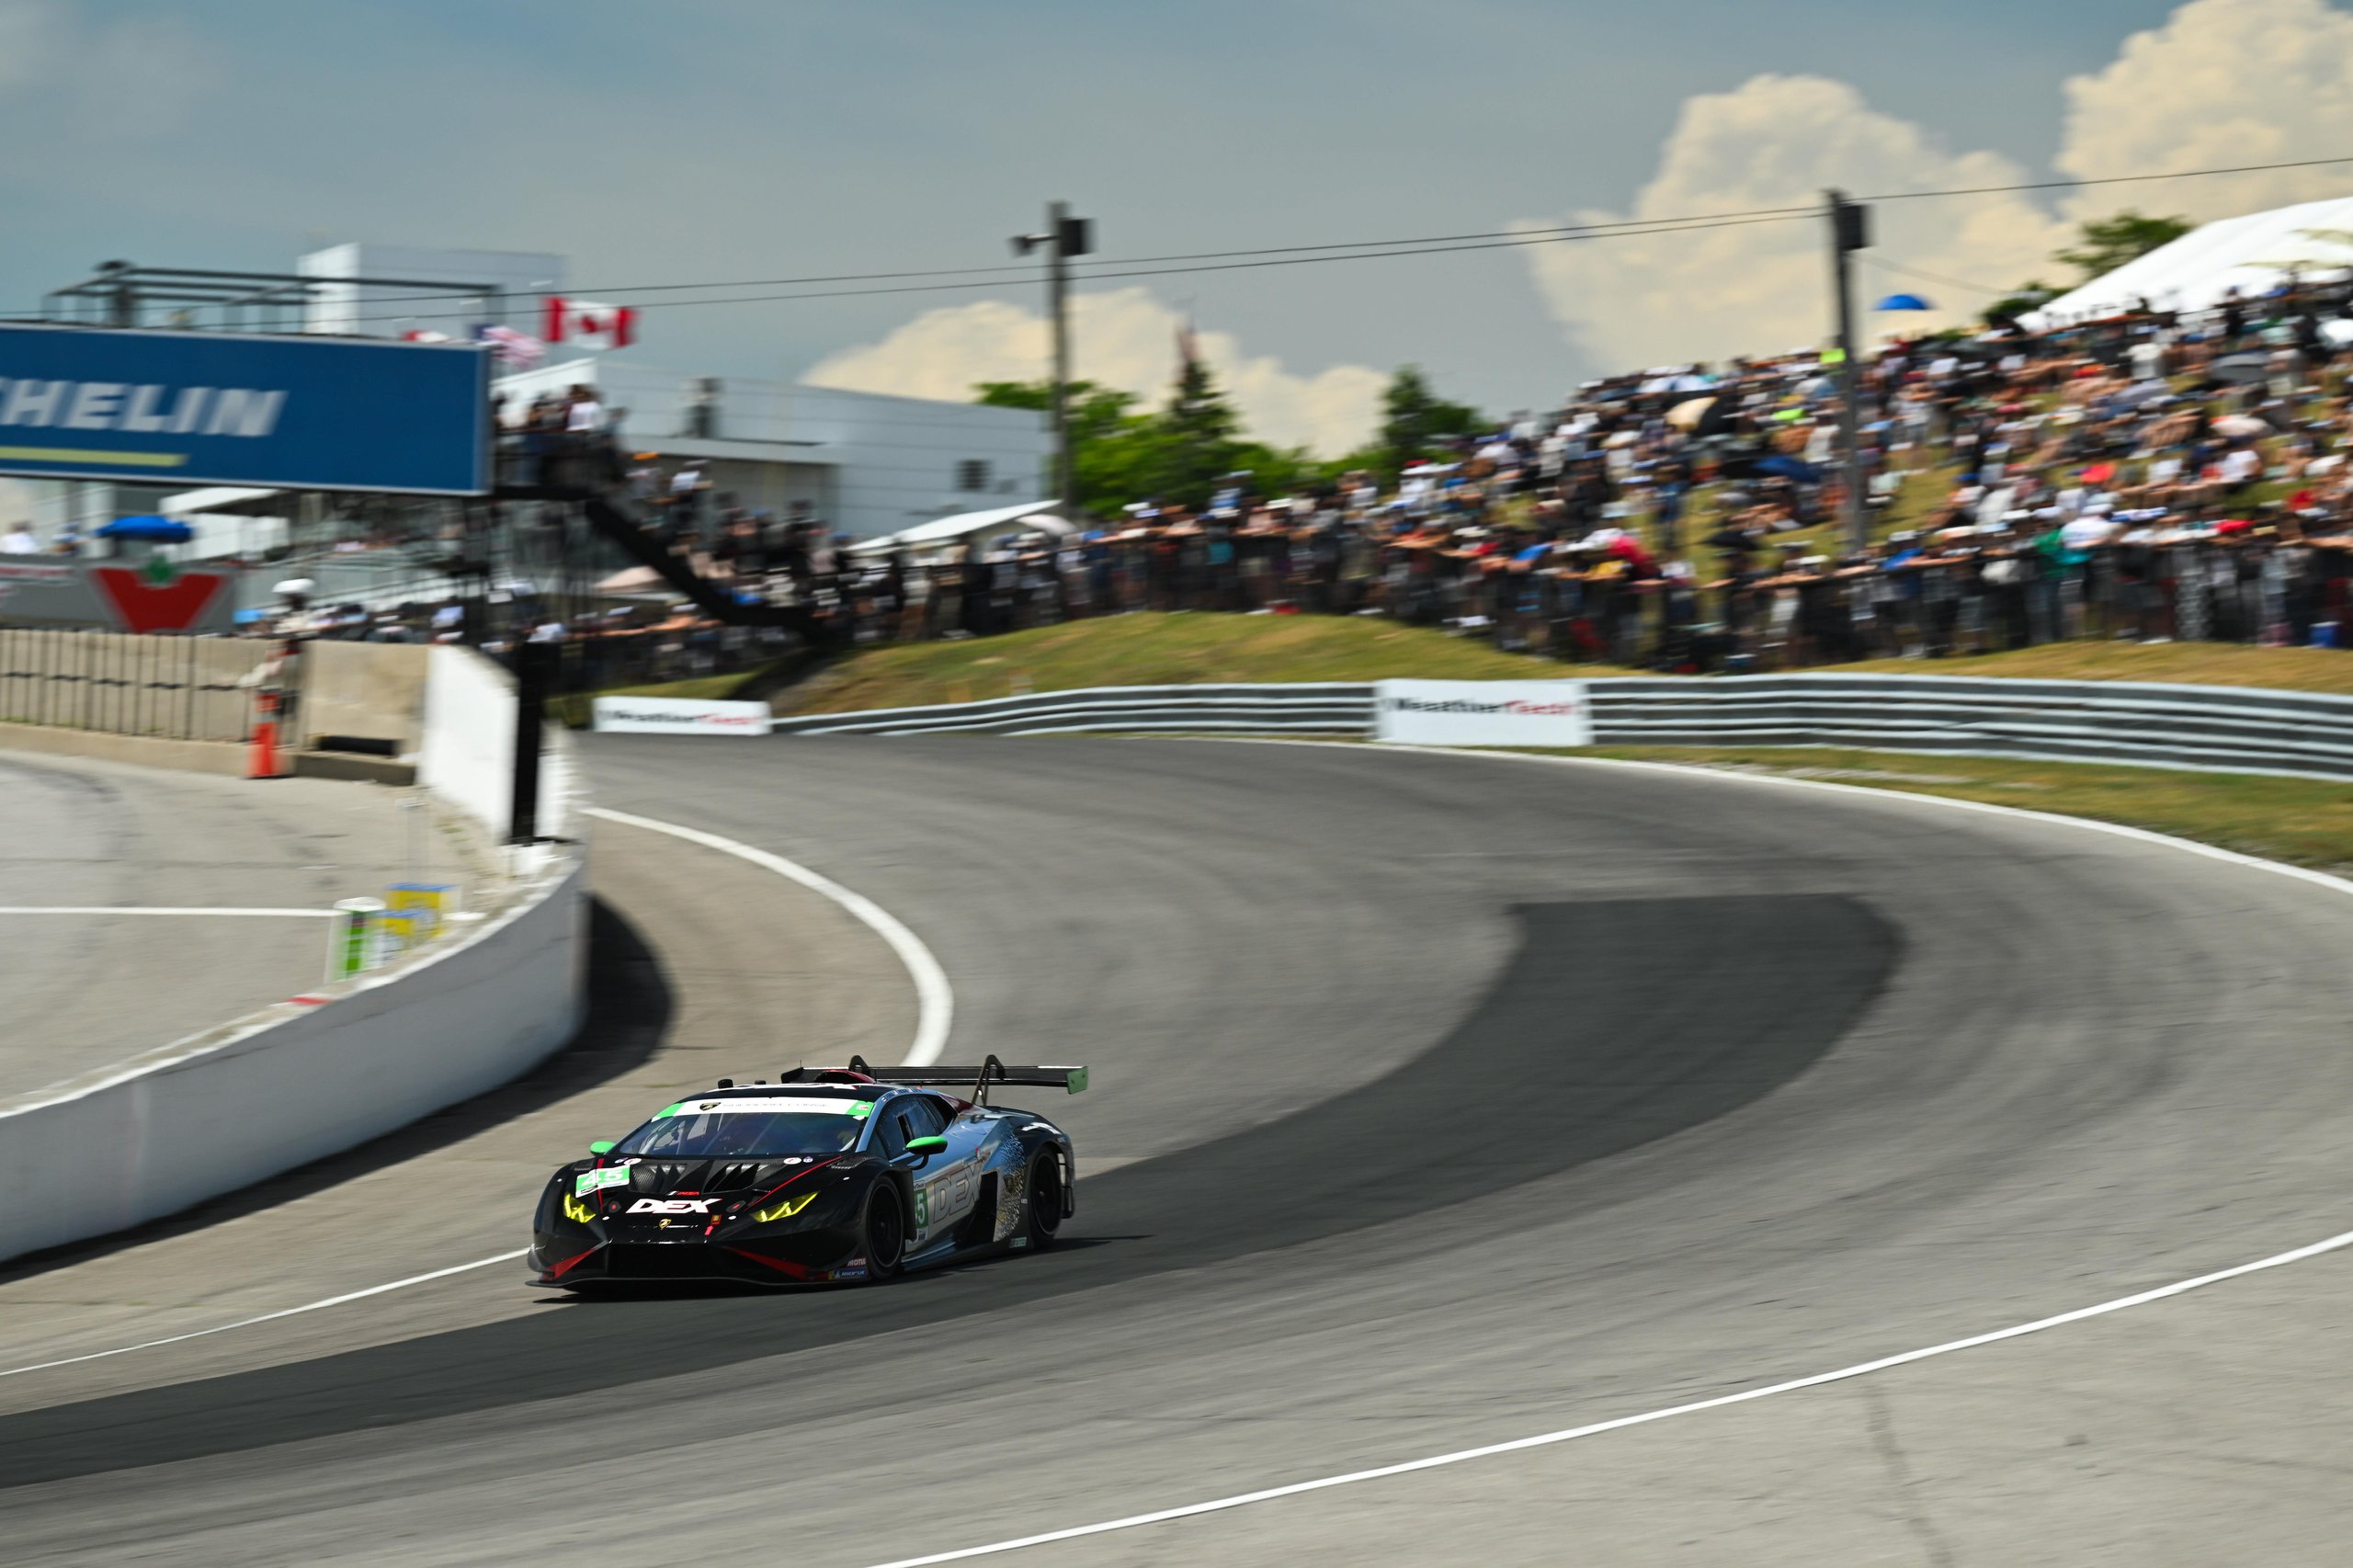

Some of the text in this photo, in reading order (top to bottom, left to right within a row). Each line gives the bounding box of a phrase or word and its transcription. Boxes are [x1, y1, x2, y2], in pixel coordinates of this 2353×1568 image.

[0, 377, 290, 437] HELIN
[581, 1169, 624, 1187] 45
[932, 1159, 984, 1224] DEX
[625, 1198, 723, 1214] DEX
[915, 1192, 926, 1225] 5
